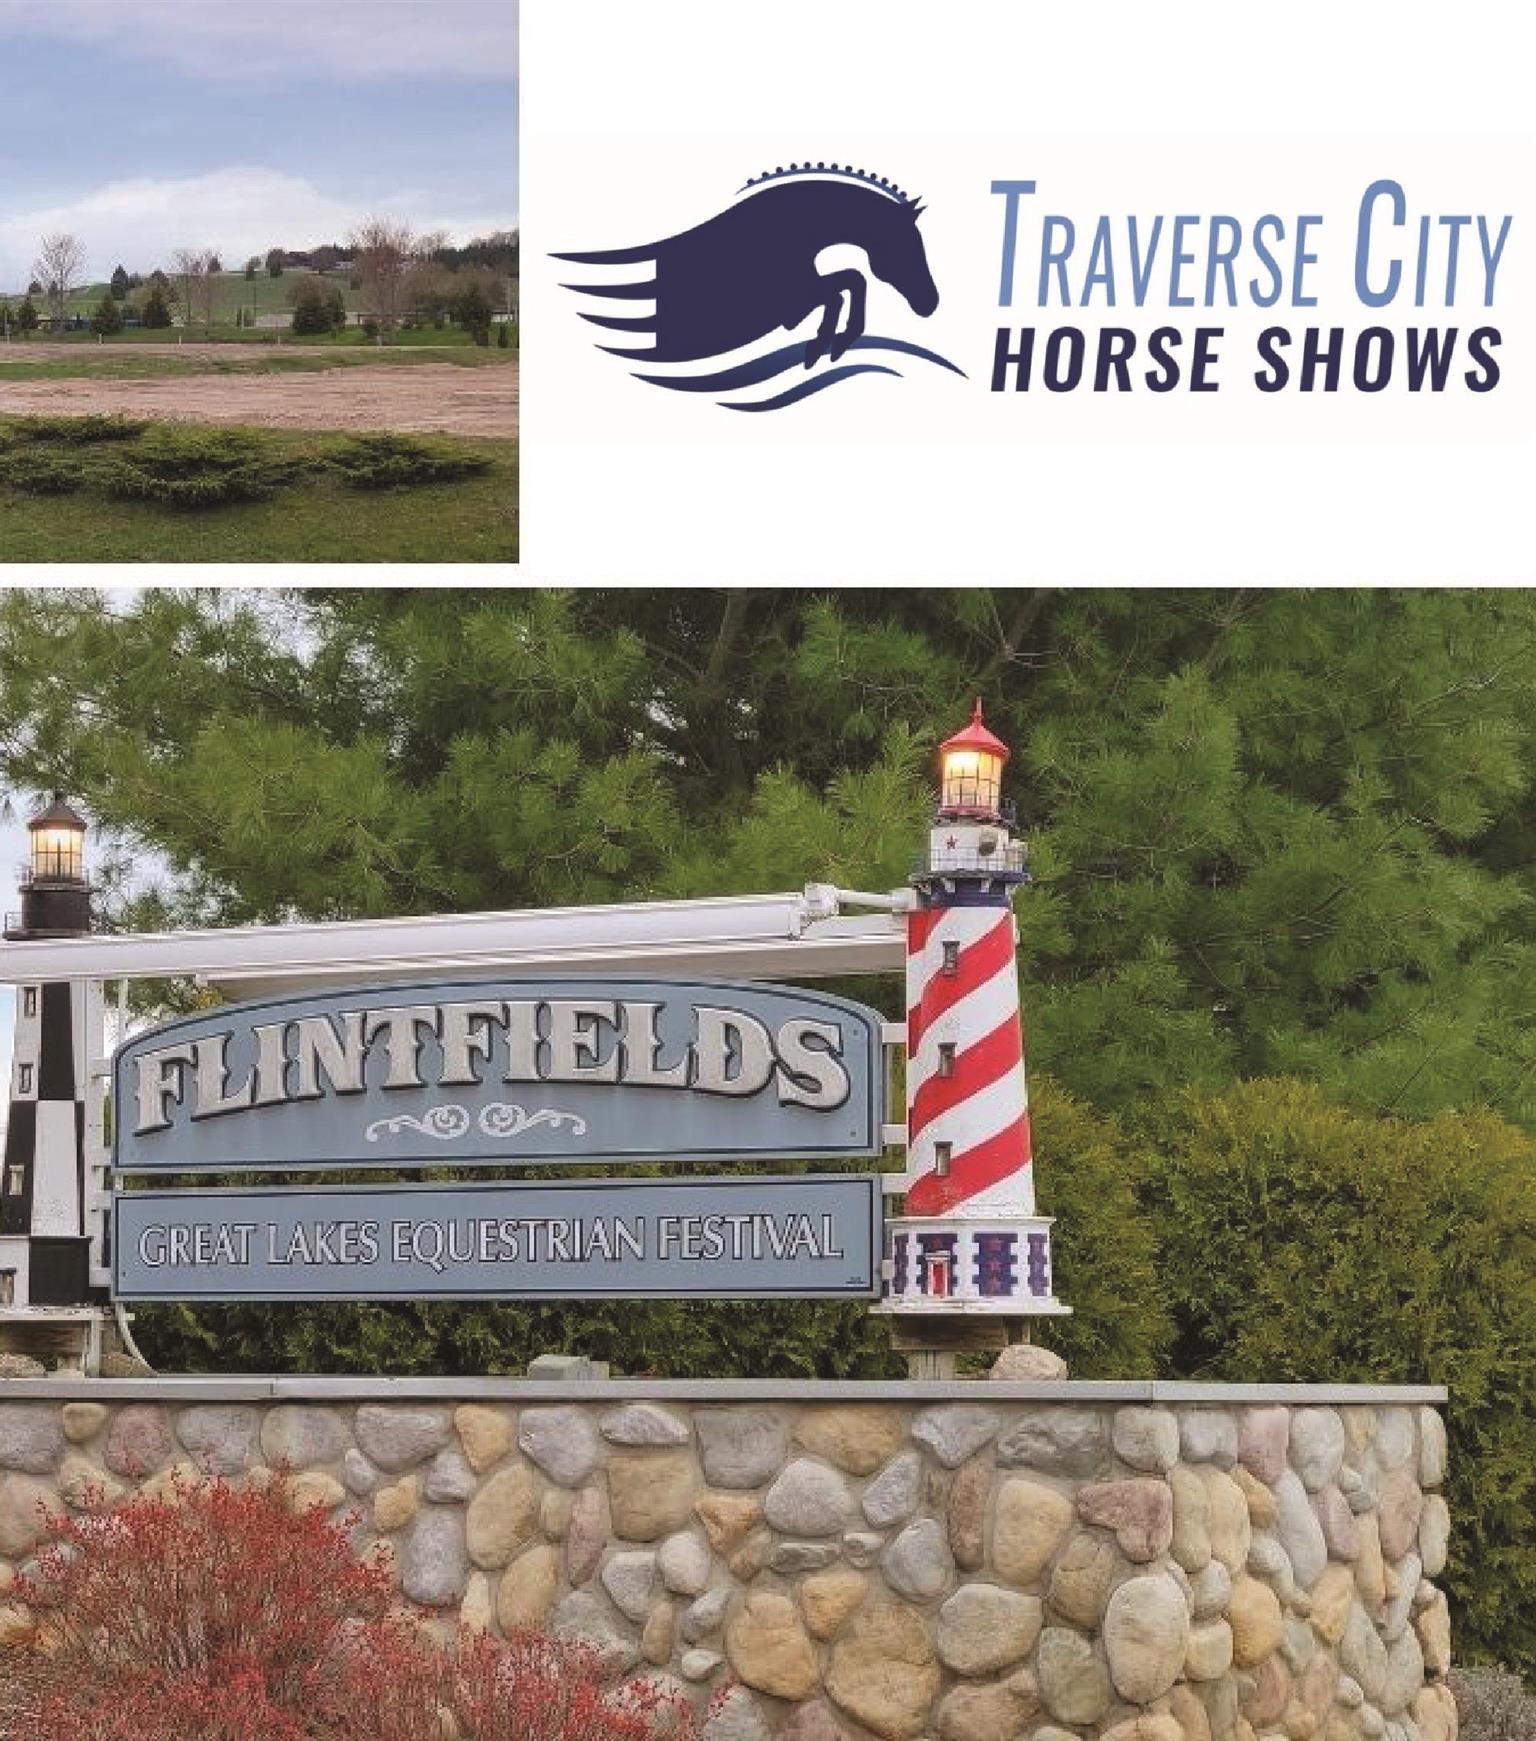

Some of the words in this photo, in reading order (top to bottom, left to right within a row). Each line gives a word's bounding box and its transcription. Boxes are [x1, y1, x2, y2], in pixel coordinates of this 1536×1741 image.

[134, 1000, 852, 1138] FLINTFIELDS
[139, 1223, 257, 1267] GREAT
[267, 1220, 381, 1264] LAKES
[391, 1217, 646, 1273] EQUESTRIAN
[657, 1213, 844, 1261] FESTIVAL
